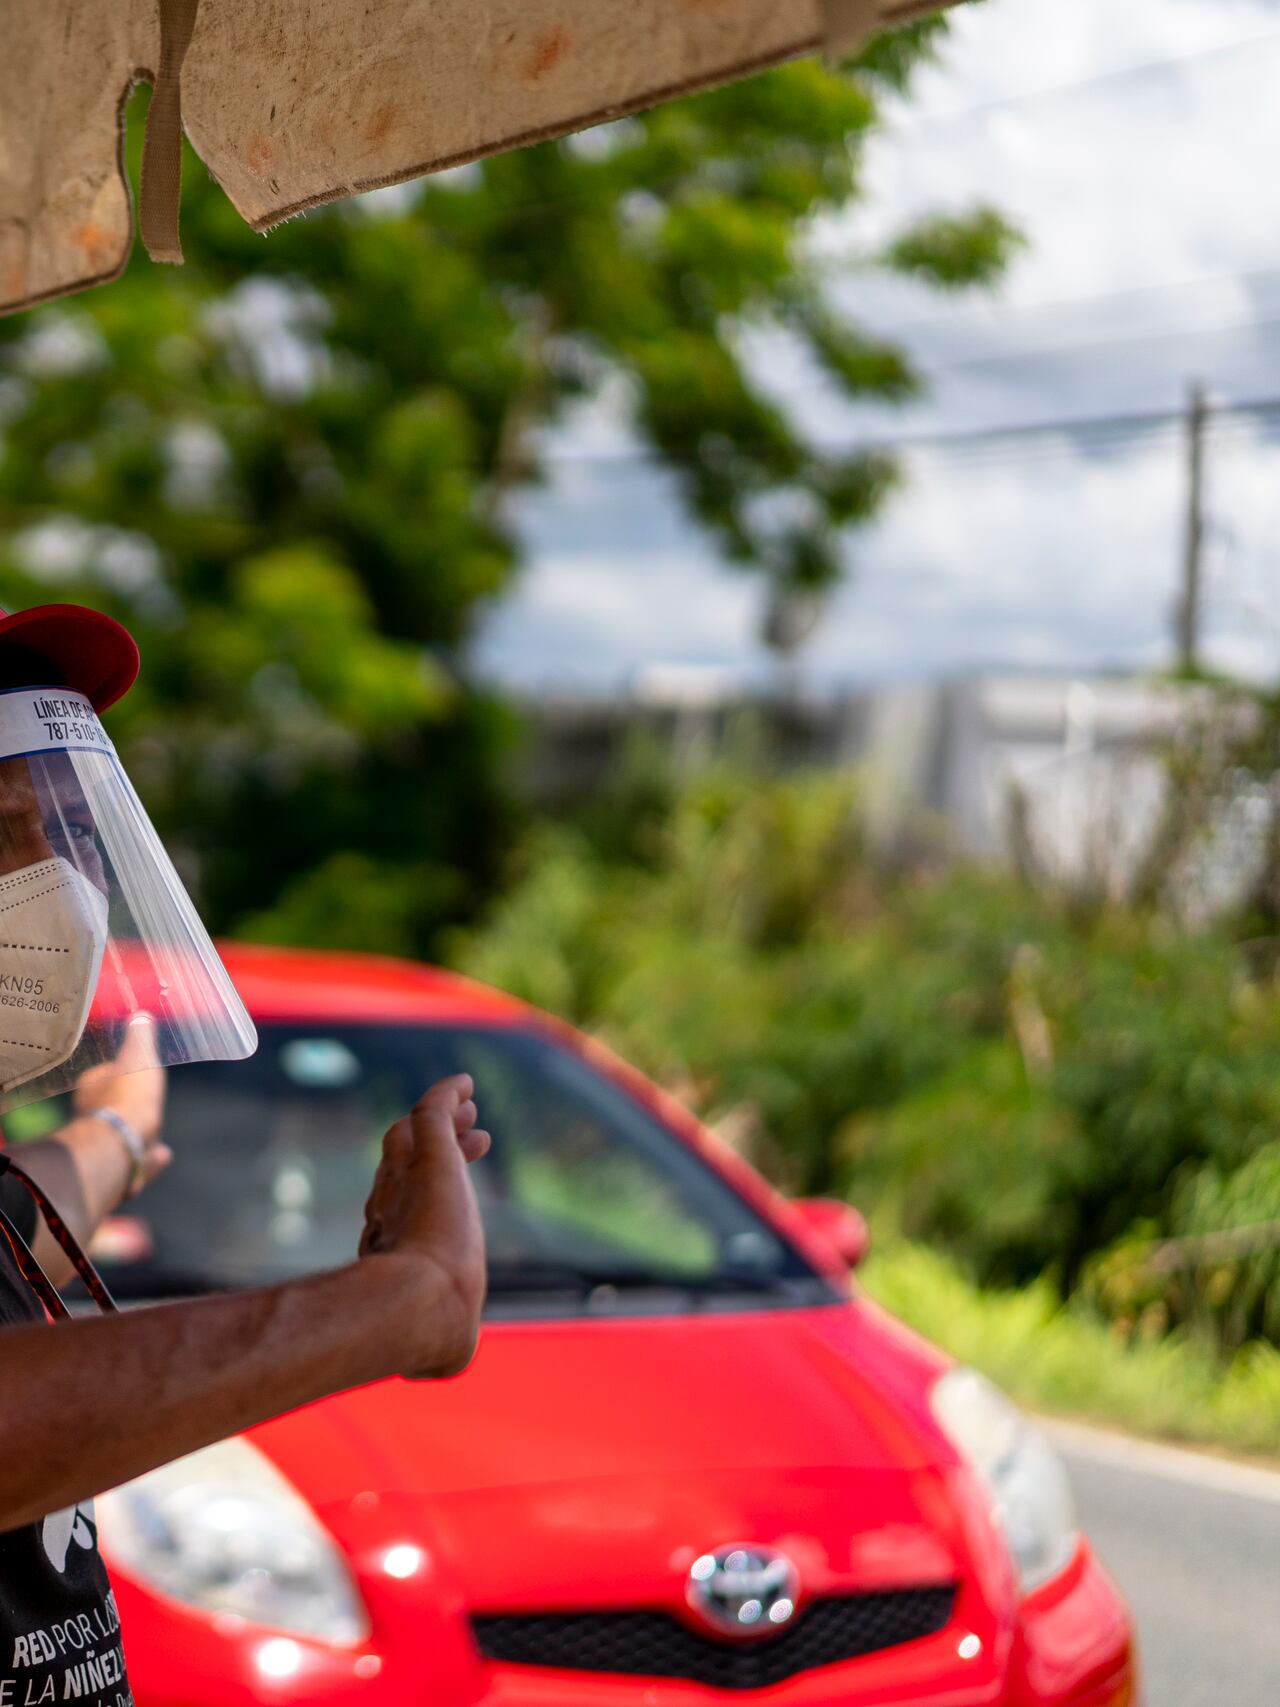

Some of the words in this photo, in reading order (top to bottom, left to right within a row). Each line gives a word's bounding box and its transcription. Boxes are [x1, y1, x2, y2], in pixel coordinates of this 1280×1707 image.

[33, 697, 71, 719] LÍNEA
[70, 701, 85, 719] DE
[12, 1629, 56, 1668] RED
[51, 1613, 99, 1654] POR
[24, 1674, 55, 1706] LA
[63, 1649, 122, 1700] NIÑEZ
